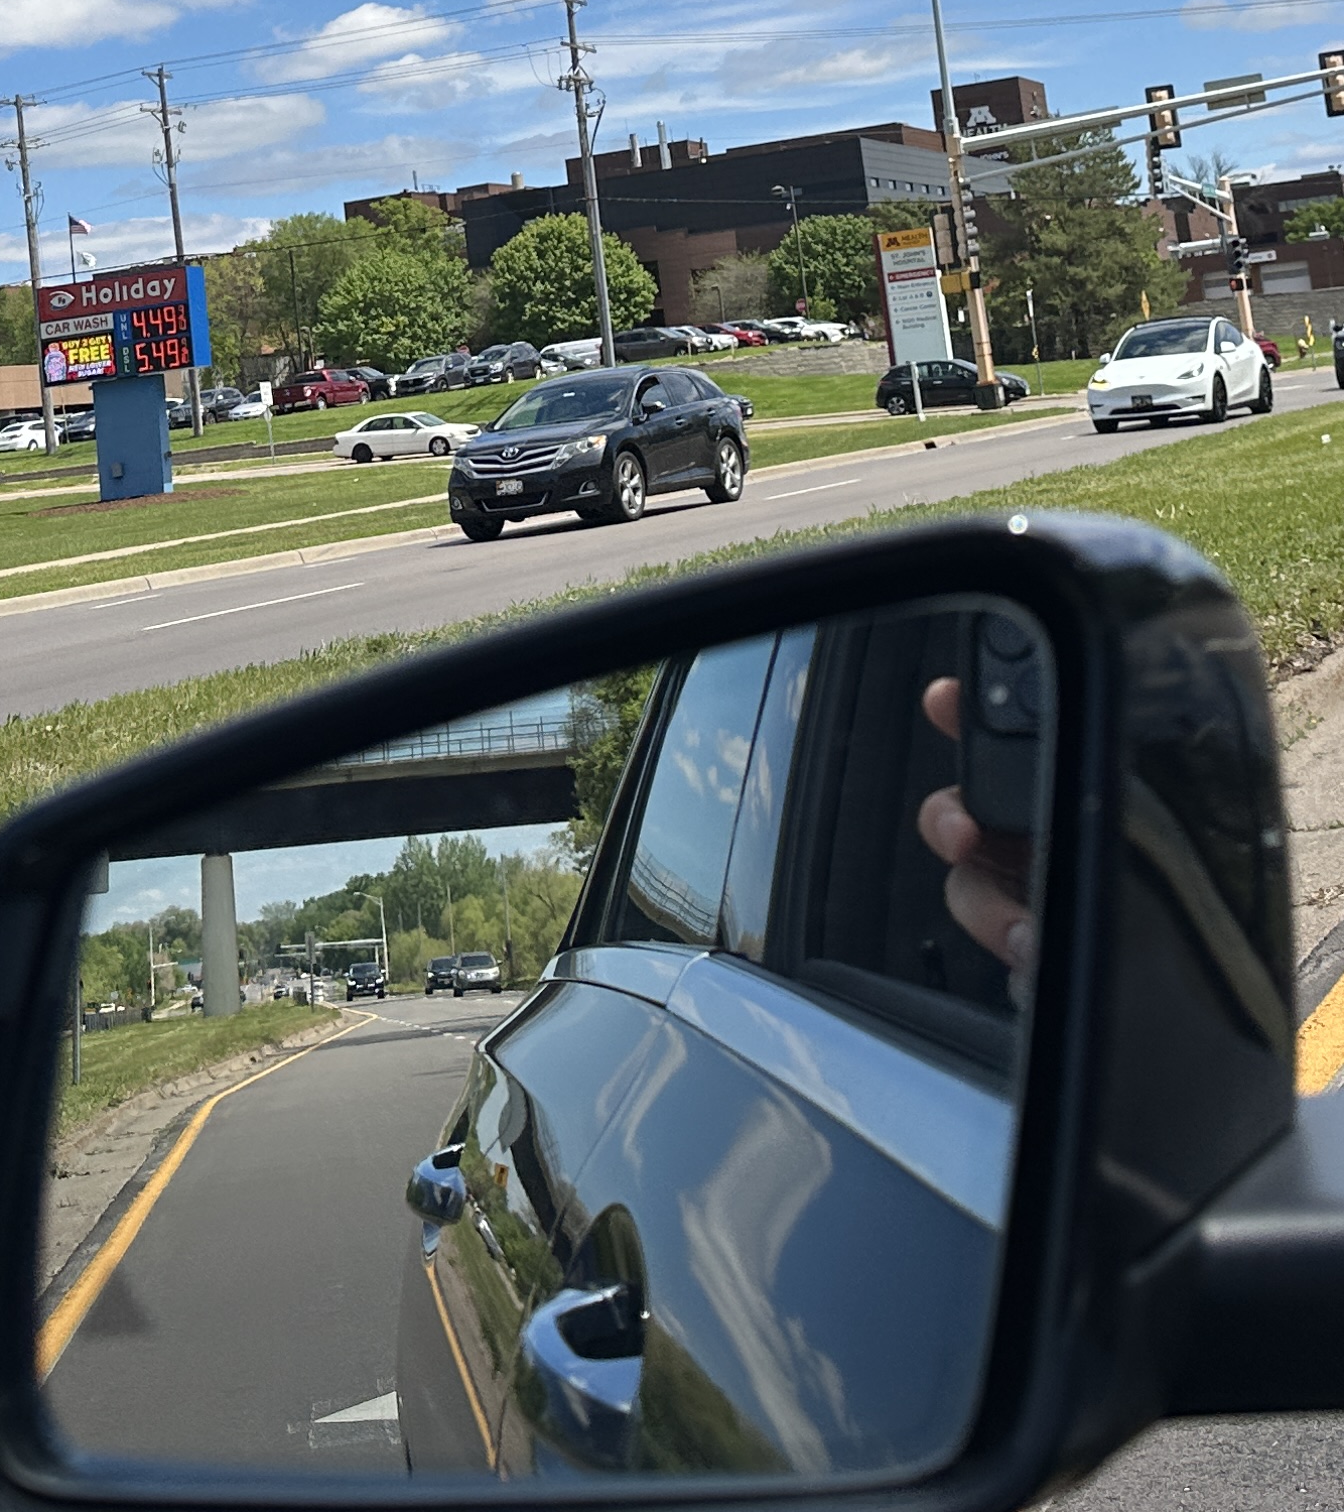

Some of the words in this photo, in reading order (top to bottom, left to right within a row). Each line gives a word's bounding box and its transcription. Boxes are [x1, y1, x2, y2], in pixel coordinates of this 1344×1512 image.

[81, 277, 176, 307] Holiday
[45, 322, 70, 335] CAR
[73, 316, 109, 332] WASH
[119, 314, 128, 340] UNL
[132, 306, 177, 338] 4.49
[68, 344, 111, 365] FREE
[122, 347, 131, 373] DSL
[135, 338, 181, 372] 5.49
